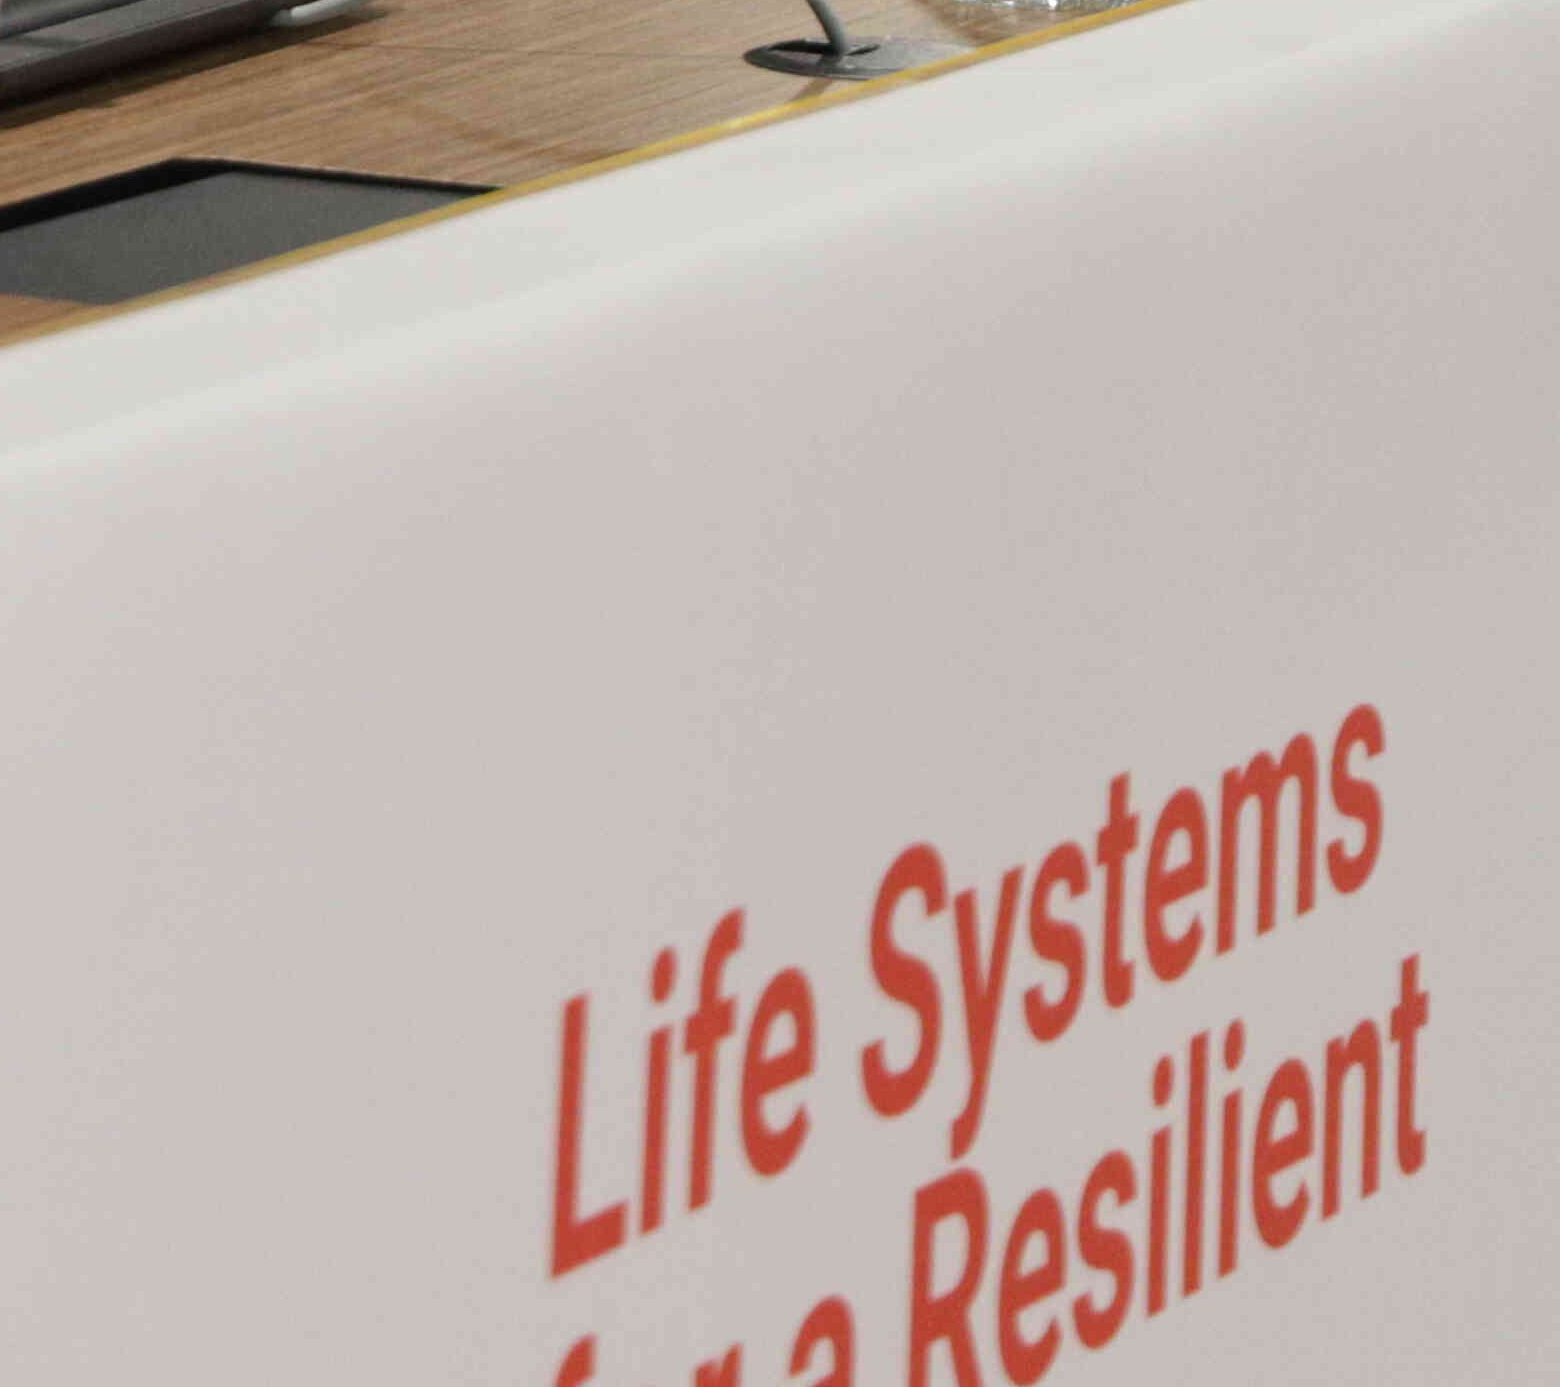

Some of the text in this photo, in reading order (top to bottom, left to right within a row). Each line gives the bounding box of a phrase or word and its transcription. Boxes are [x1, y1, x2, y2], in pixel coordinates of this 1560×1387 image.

[549, 702, 1386, 1279] Life Systems
[906, 951, 1430, 1387] Resilient
